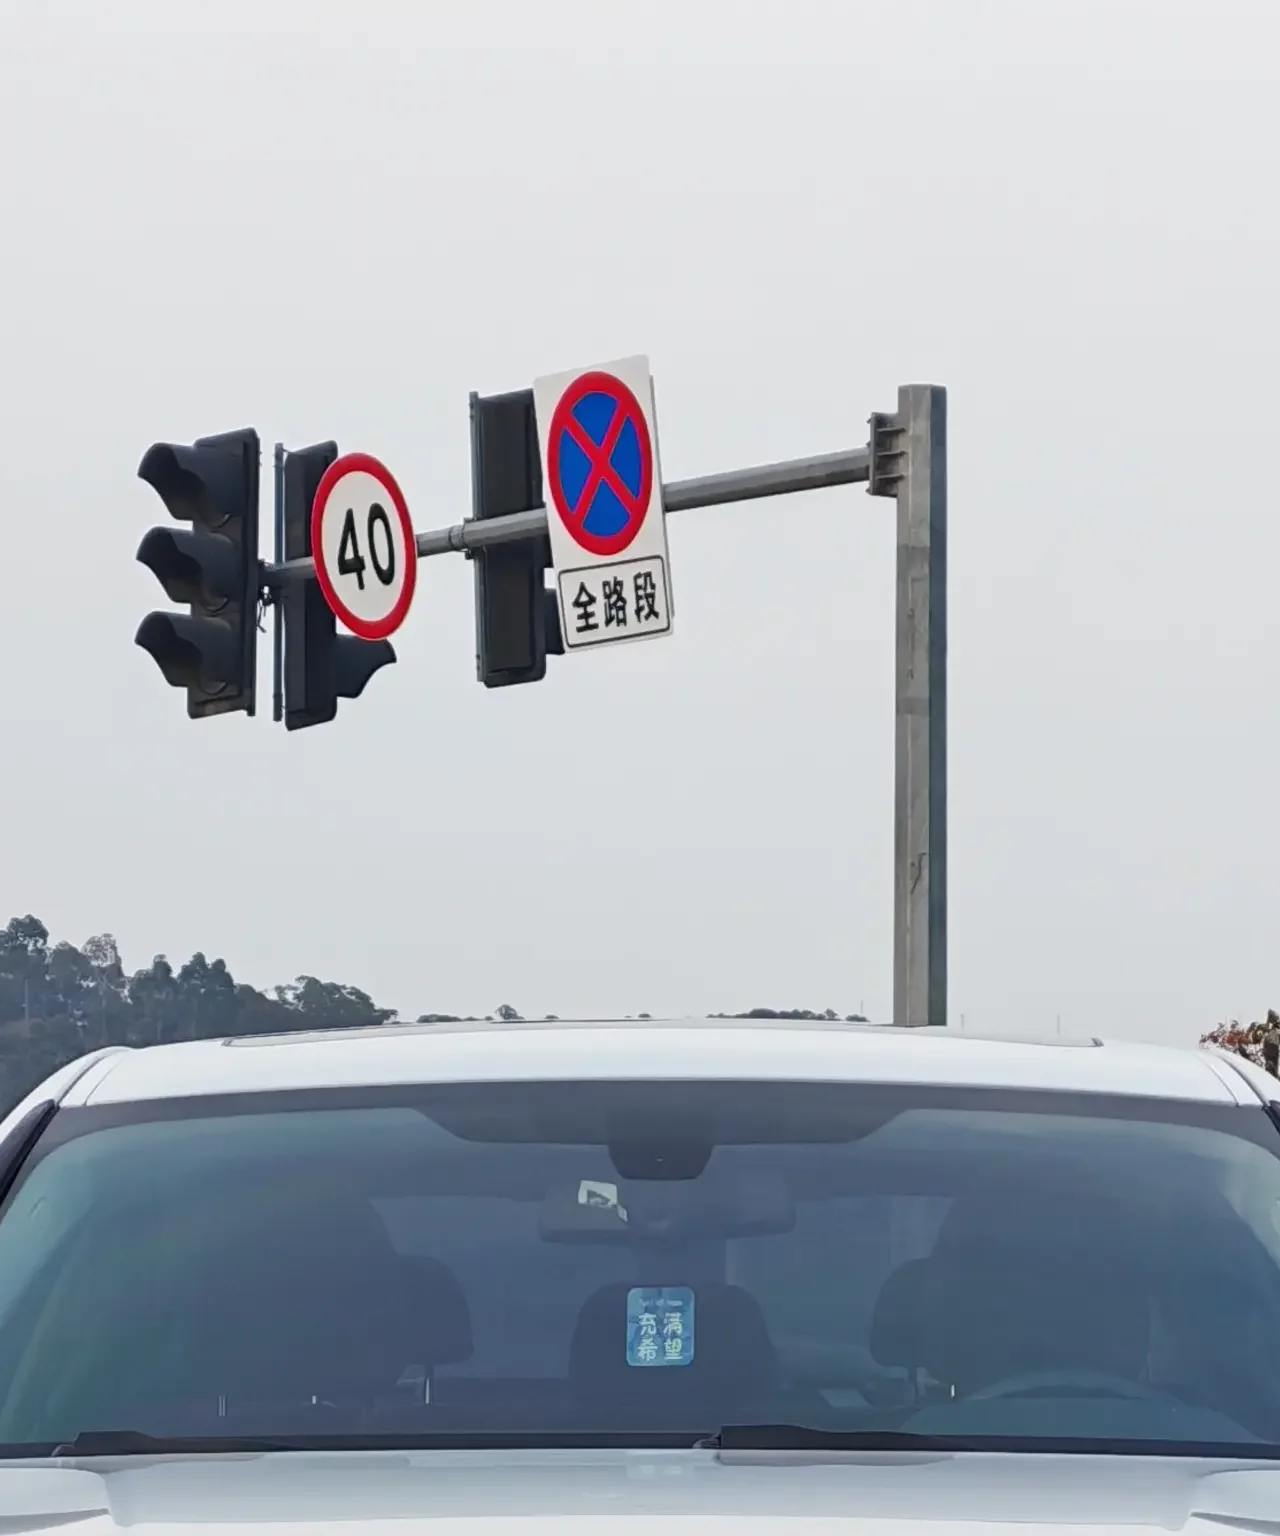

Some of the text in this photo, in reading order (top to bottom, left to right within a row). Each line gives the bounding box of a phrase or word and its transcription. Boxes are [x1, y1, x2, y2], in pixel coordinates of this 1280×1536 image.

[338, 502, 395, 590] 40
[571, 571, 660, 633] 全路段
